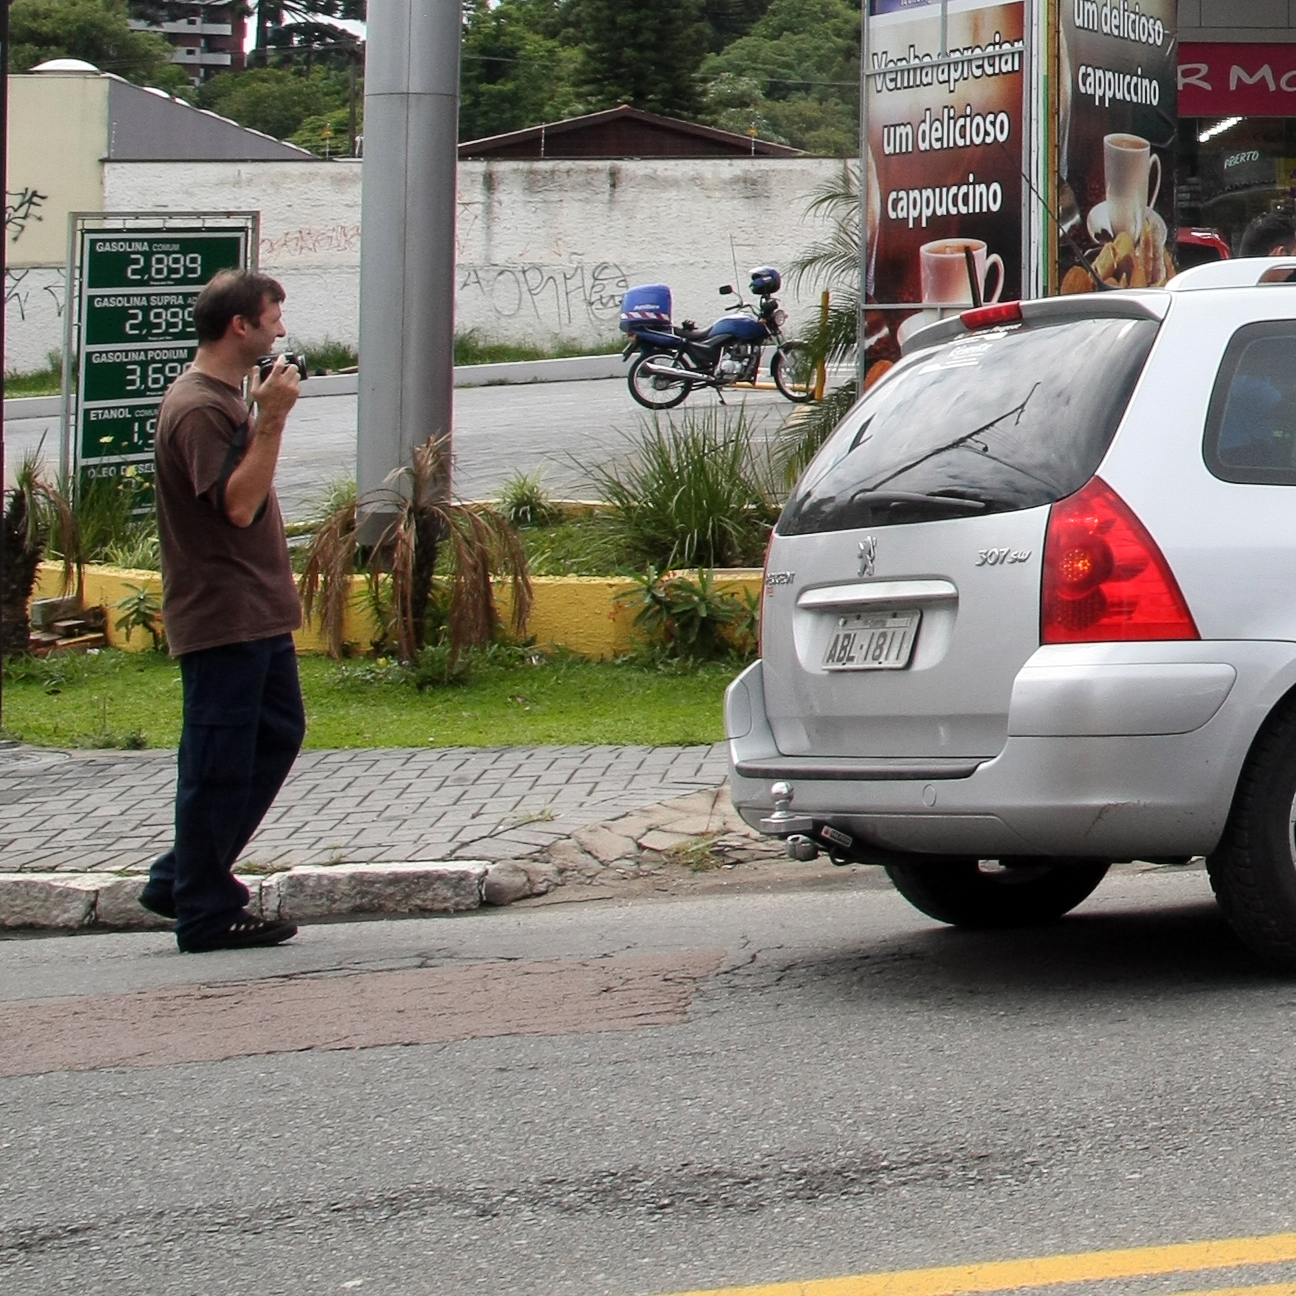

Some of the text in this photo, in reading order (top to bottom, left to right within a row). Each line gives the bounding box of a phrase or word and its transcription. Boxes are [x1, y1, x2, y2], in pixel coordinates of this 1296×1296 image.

[873, 32, 1023, 93] Venha apreciar
[1078, 64, 1160, 107] cappuccino
[883, 104, 1010, 156] um delicioso
[1224, 150, 1260, 170] ABERTO
[887, 172, 1003, 229] cappuccino
[96, 241, 149, 252] GASOLINA
[127, 254, 202, 280] 2,899
[94, 296, 147, 308] GASOLINA
[150, 295, 184, 306] SUPRA
[92, 348, 188, 364] GASOLINA PODIUM
[90, 409, 131, 421] ETANOL
[975, 548, 1008, 566] 307
